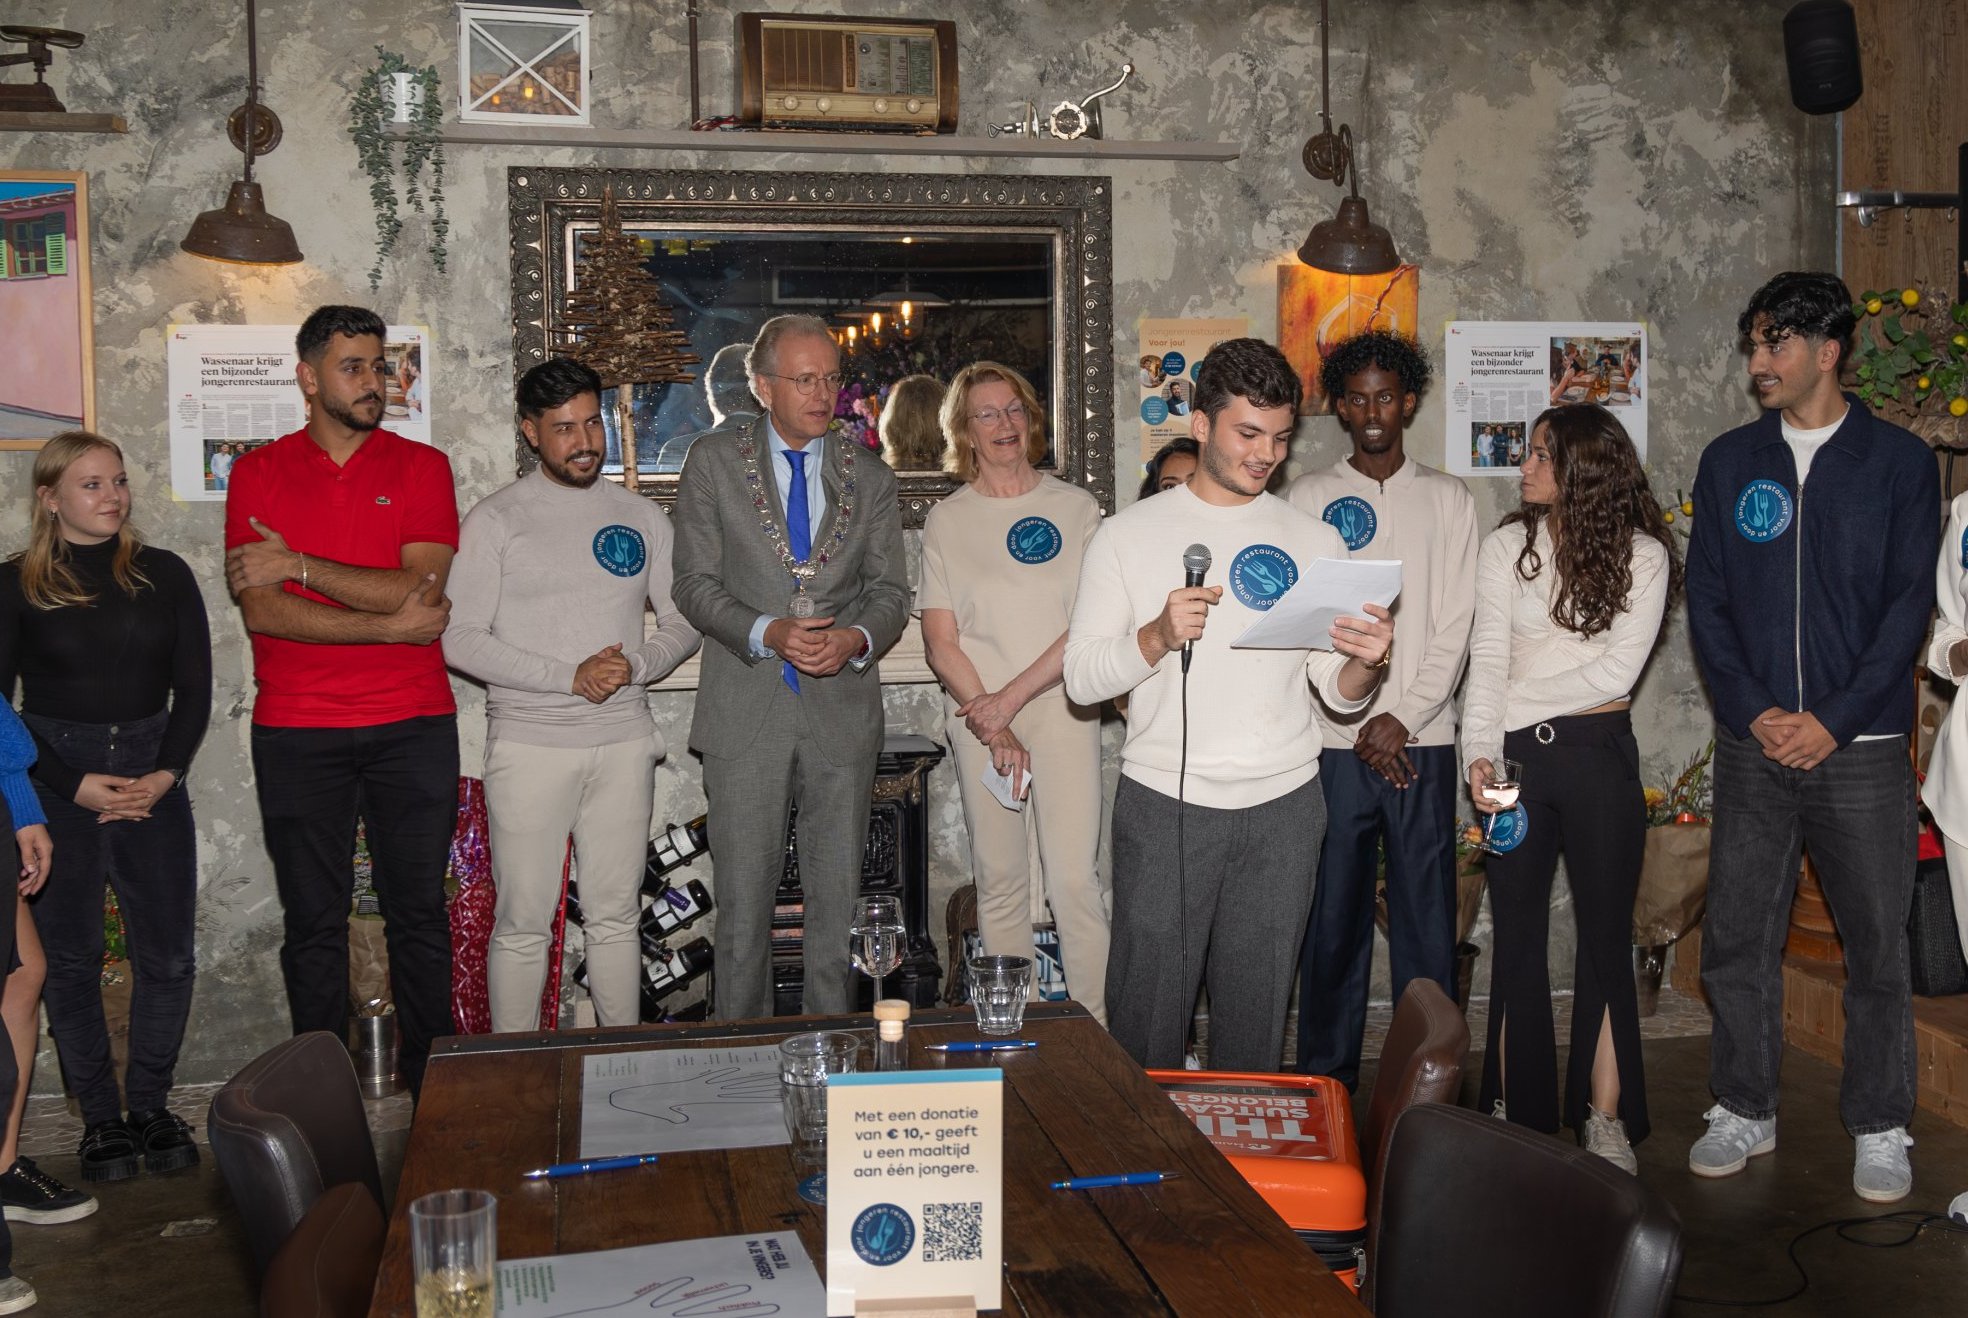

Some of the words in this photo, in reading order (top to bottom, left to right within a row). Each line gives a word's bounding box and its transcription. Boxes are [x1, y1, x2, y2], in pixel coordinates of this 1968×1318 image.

[1170, 339, 1185, 348] jou!
[201, 357, 253, 365] Wassenaar
[256, 356, 283, 367] krijgt
[1471, 349, 1512, 357] Wassenaar
[1513, 349, 1534, 359] krijgt
[1486, 358, 1524, 367] bijzonder
[201, 368, 219, 376] een
[222, 367, 269, 377] bijzonder
[1470, 367, 1544, 376] jongerenrestaurant
[201, 377, 297, 387] jongerenrestaurant
[1738, 486, 1757, 520] jongeren
[1758, 484, 1788, 515] restaurant
[1326, 502, 1343, 520] geren
[1344, 500, 1373, 528] restaurant
[1015, 520, 1047, 532] jongeren
[1741, 523, 1756, 536] door
[1770, 518, 1785, 534] voor
[596, 529, 616, 554] jongeren
[617, 528, 644, 559] restaurant
[1044, 526, 1059, 559] restaurant
[1358, 531, 1371, 545] voor
[1015, 550, 1024, 558] en
[1241, 548, 1289, 565] restaurant
[601, 556, 617, 569] door
[631, 560, 642, 572] voor
[1234, 563, 1254, 603] jongeren
[1513, 820, 1524, 839] door
[1187, 1094, 1308, 1108] BELONGS
[855, 1111, 883, 1123] Met
[888, 1111, 916, 1121] een
[920, 1106, 979, 1120] donatie
[855, 1130, 882, 1141] van
[887, 1128, 898, 1139] €
[903, 1127, 931, 1141] 10,-
[935, 1125, 978, 1141] geeft
[1188, 1115, 1316, 1142] THI
[863, 1149, 872, 1159] u
[877, 1147, 905, 1158] een
[909, 1144, 970, 1159] maaltijd
[854, 1167, 882, 1178] aan
[887, 1163, 914, 1176] één
[918, 1163, 979, 1179] jongere.
[856, 1207, 888, 1233] jongeren
[890, 1209, 911, 1249] restaurant
[856, 1237, 869, 1255] door
